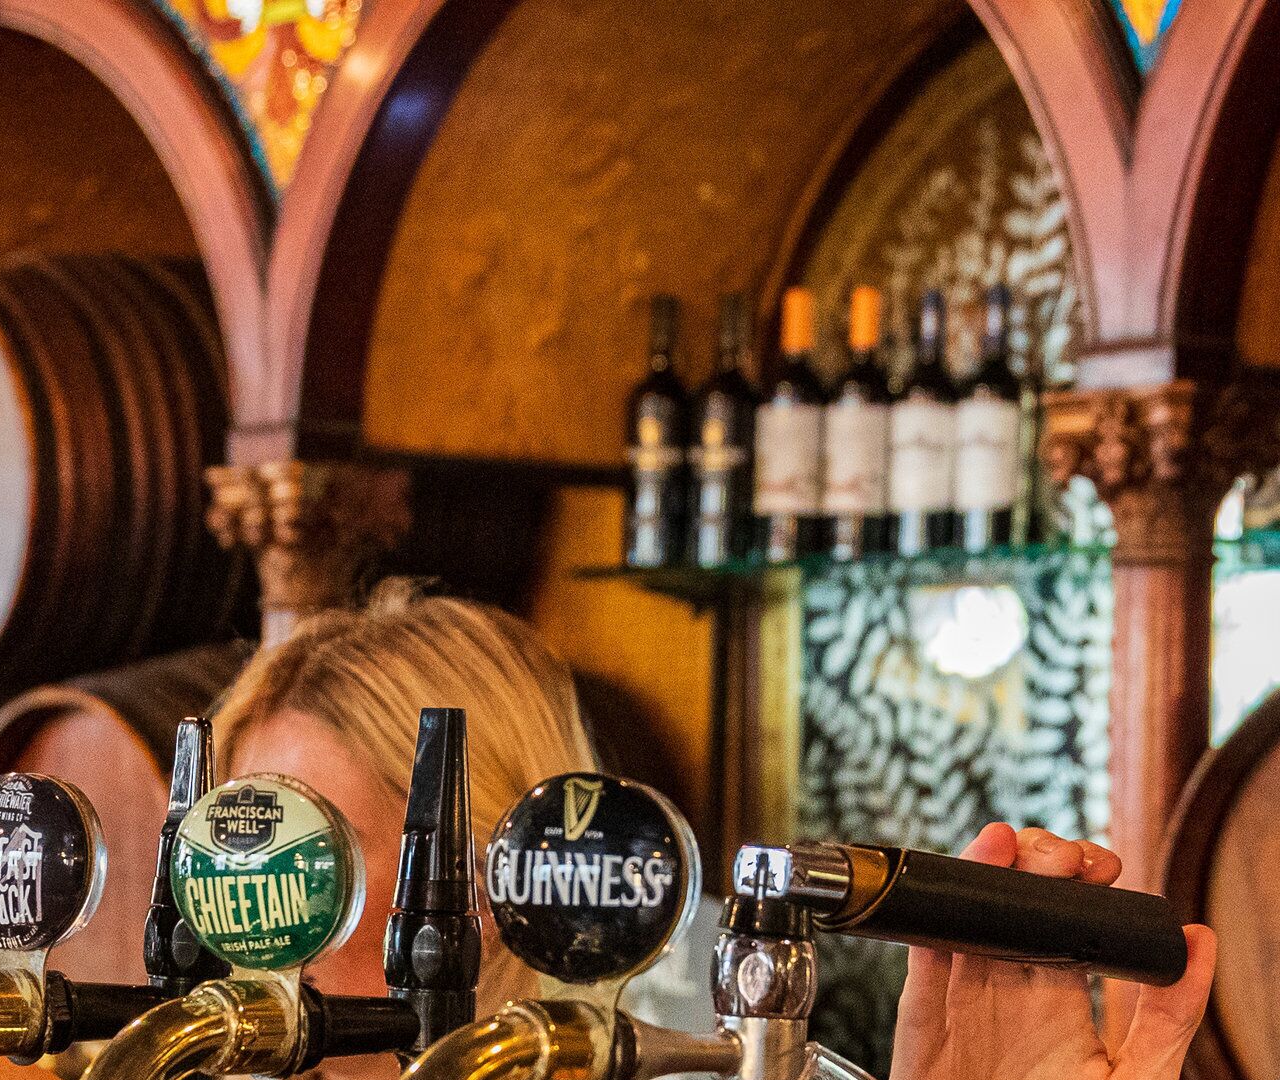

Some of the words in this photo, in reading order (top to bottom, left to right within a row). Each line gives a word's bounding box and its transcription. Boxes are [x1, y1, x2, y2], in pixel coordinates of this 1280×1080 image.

[207, 805, 282, 821] FRANCISCAN
[486, 840, 668, 908] GUINNESS
[185, 872, 310, 935] CHIEFTAIN
[221, 940, 248, 952] IRISH
[248, 938, 272, 950] PALE
[274, 934, 291, 948] ALE
